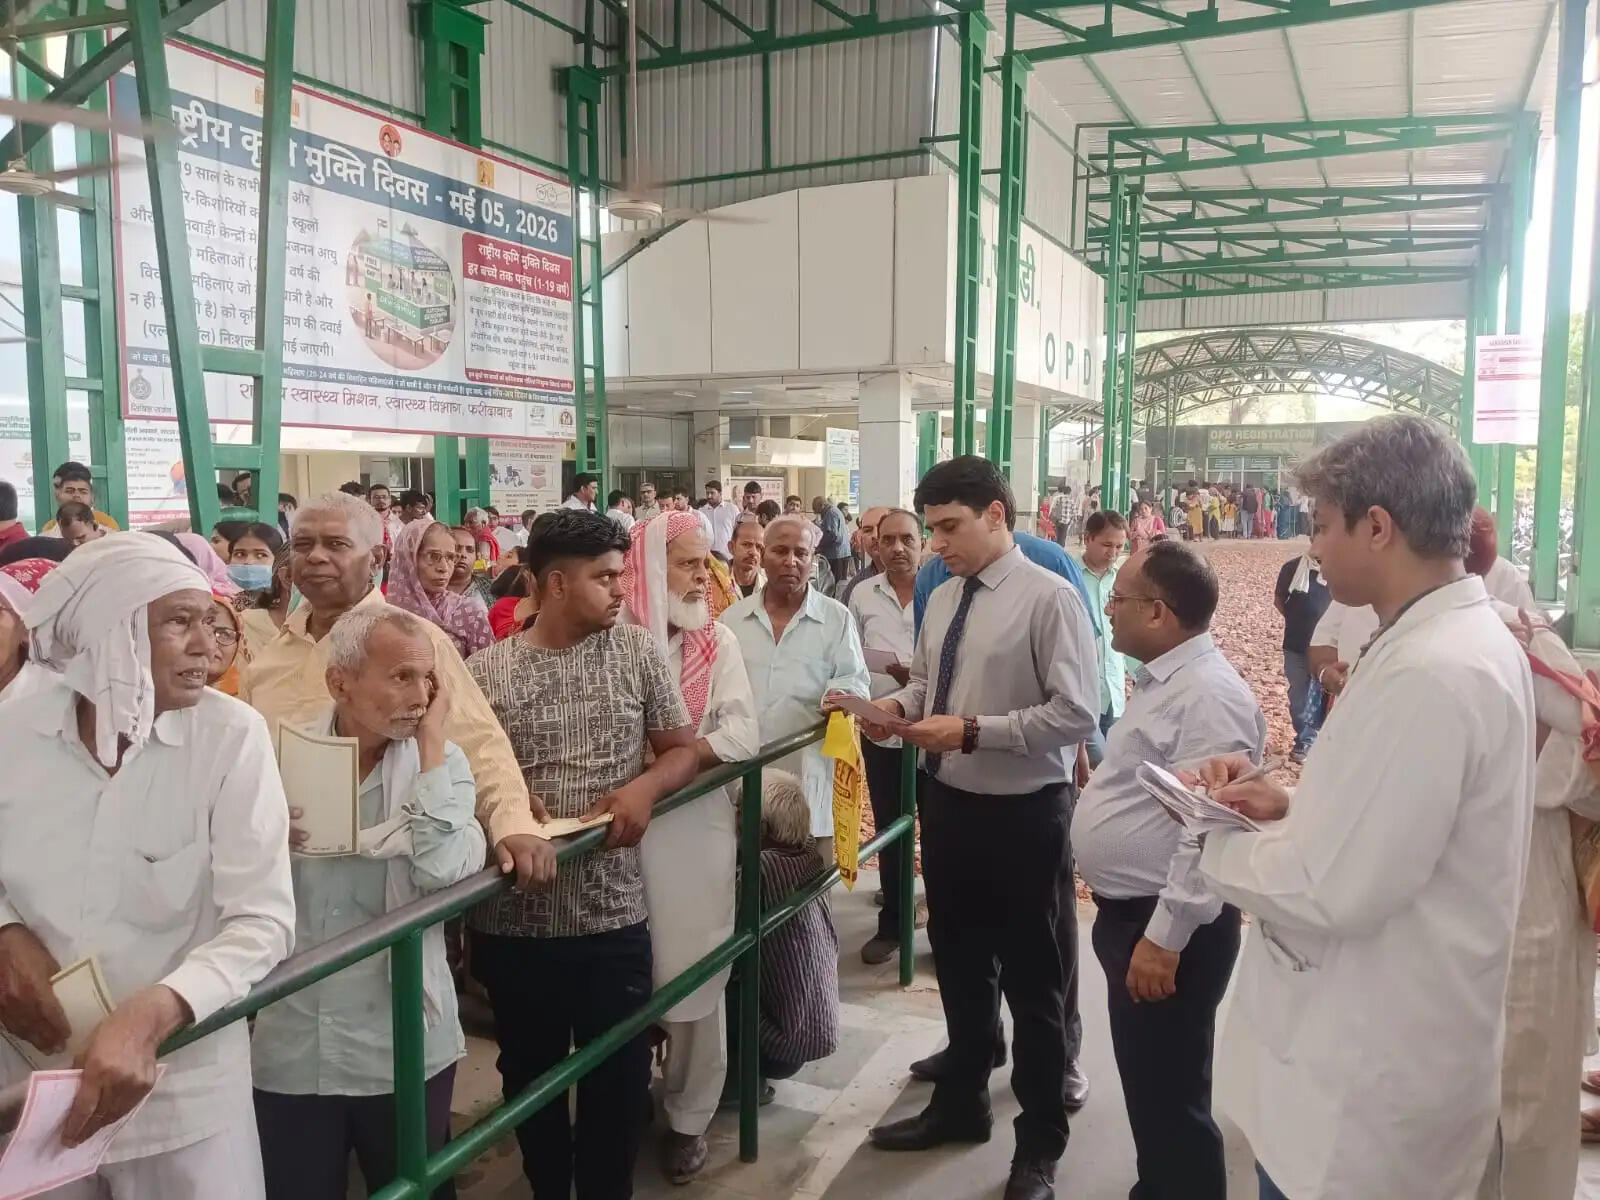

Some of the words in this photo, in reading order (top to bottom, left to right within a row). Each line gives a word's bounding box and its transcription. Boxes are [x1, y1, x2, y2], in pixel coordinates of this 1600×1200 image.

[171, 100, 232, 149] ाष्ट्रीय
[304, 142, 367, 188] मुक्ति
[372, 157, 429, 205] दिवस
[448, 188, 476, 224] मई
[481, 199, 510, 233] 05,
[516, 209, 558, 243] 2026
[195, 166, 219, 183] साल
[223, 170, 235, 187] के
[292, 190, 311, 206] और
[291, 216, 319, 235] स्कूलों
[317, 247, 338, 265] आयु
[289, 264, 305, 280] वर्ष
[307, 266, 320, 282] की
[467, 262, 478, 276] हर
[499, 269, 514, 282] तक
[303, 315, 317, 331] की
[320, 319, 342, 336] दवाई
[290, 387, 339, 405] स्वास्थ्य
[385, 394, 426, 412] स्वास्थ्य
[1210, 429, 1232, 440] OPD
